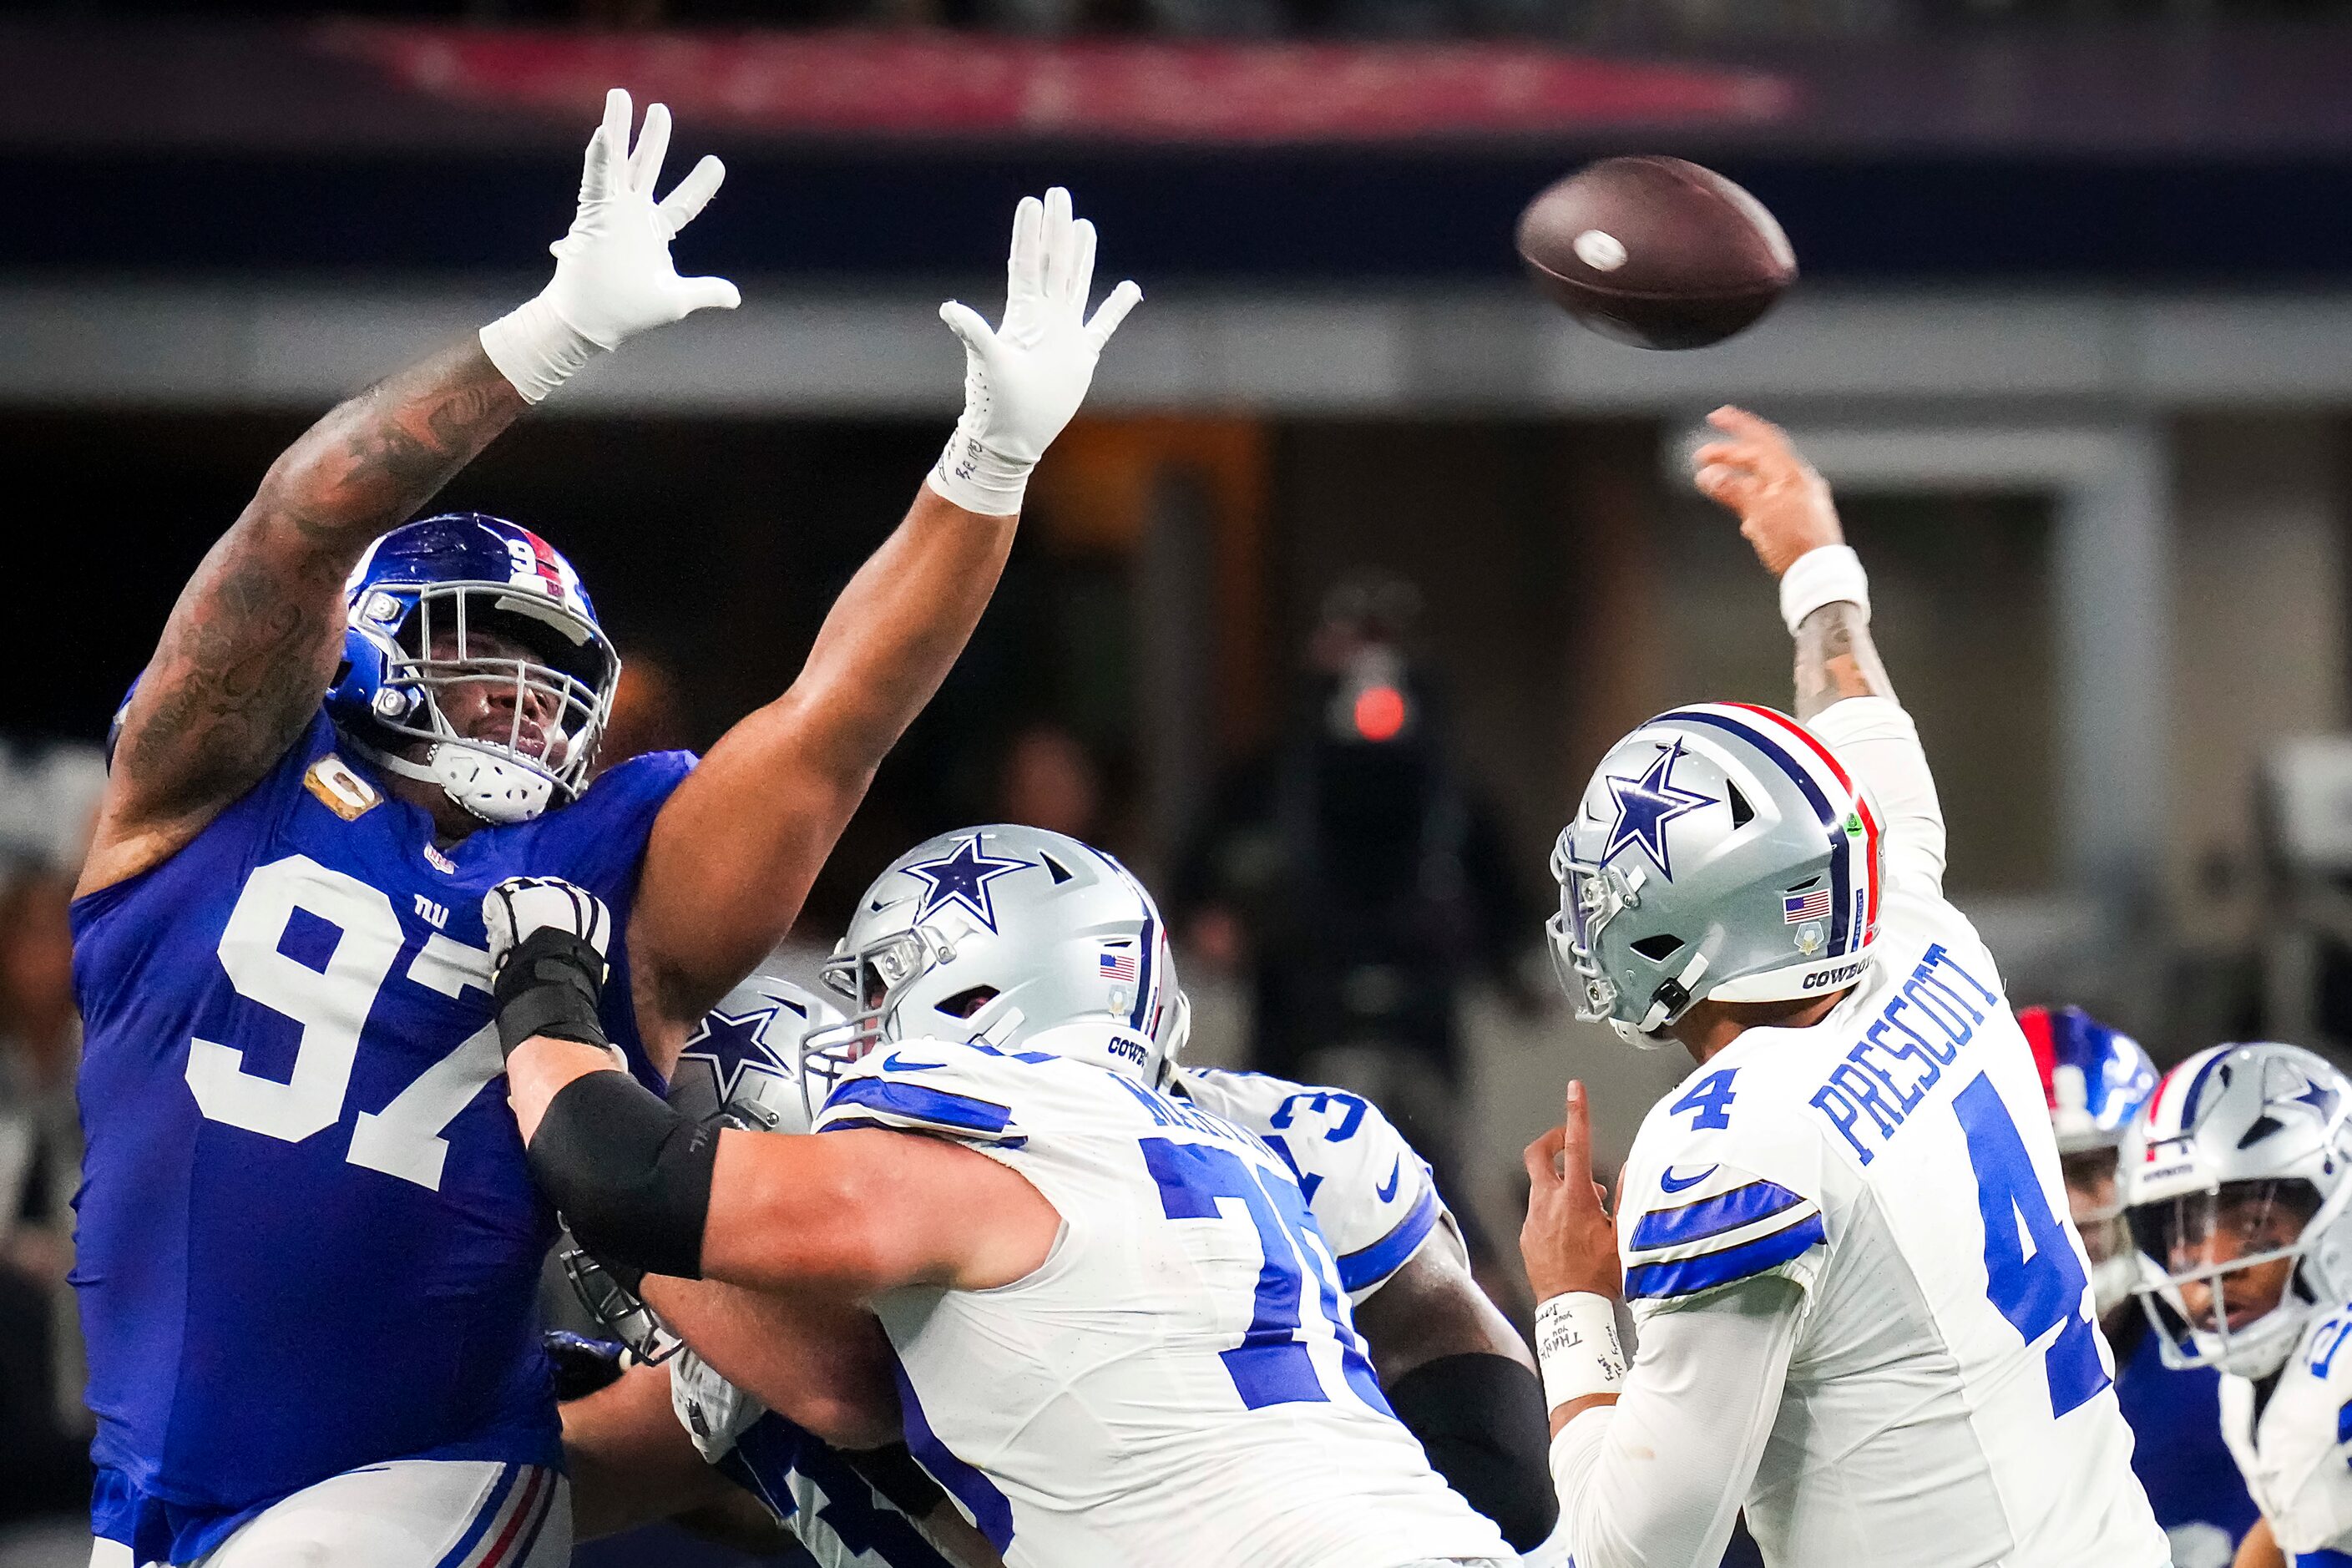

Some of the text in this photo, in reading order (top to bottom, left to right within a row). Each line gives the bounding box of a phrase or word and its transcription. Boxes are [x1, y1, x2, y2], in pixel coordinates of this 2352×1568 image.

[315, 757, 375, 808] C
[185, 853, 507, 1191] 97
[1669, 1066, 1743, 1132] 4
[1808, 942, 1998, 1166] PRESCOTT
[1951, 1070, 2113, 1420] 4
